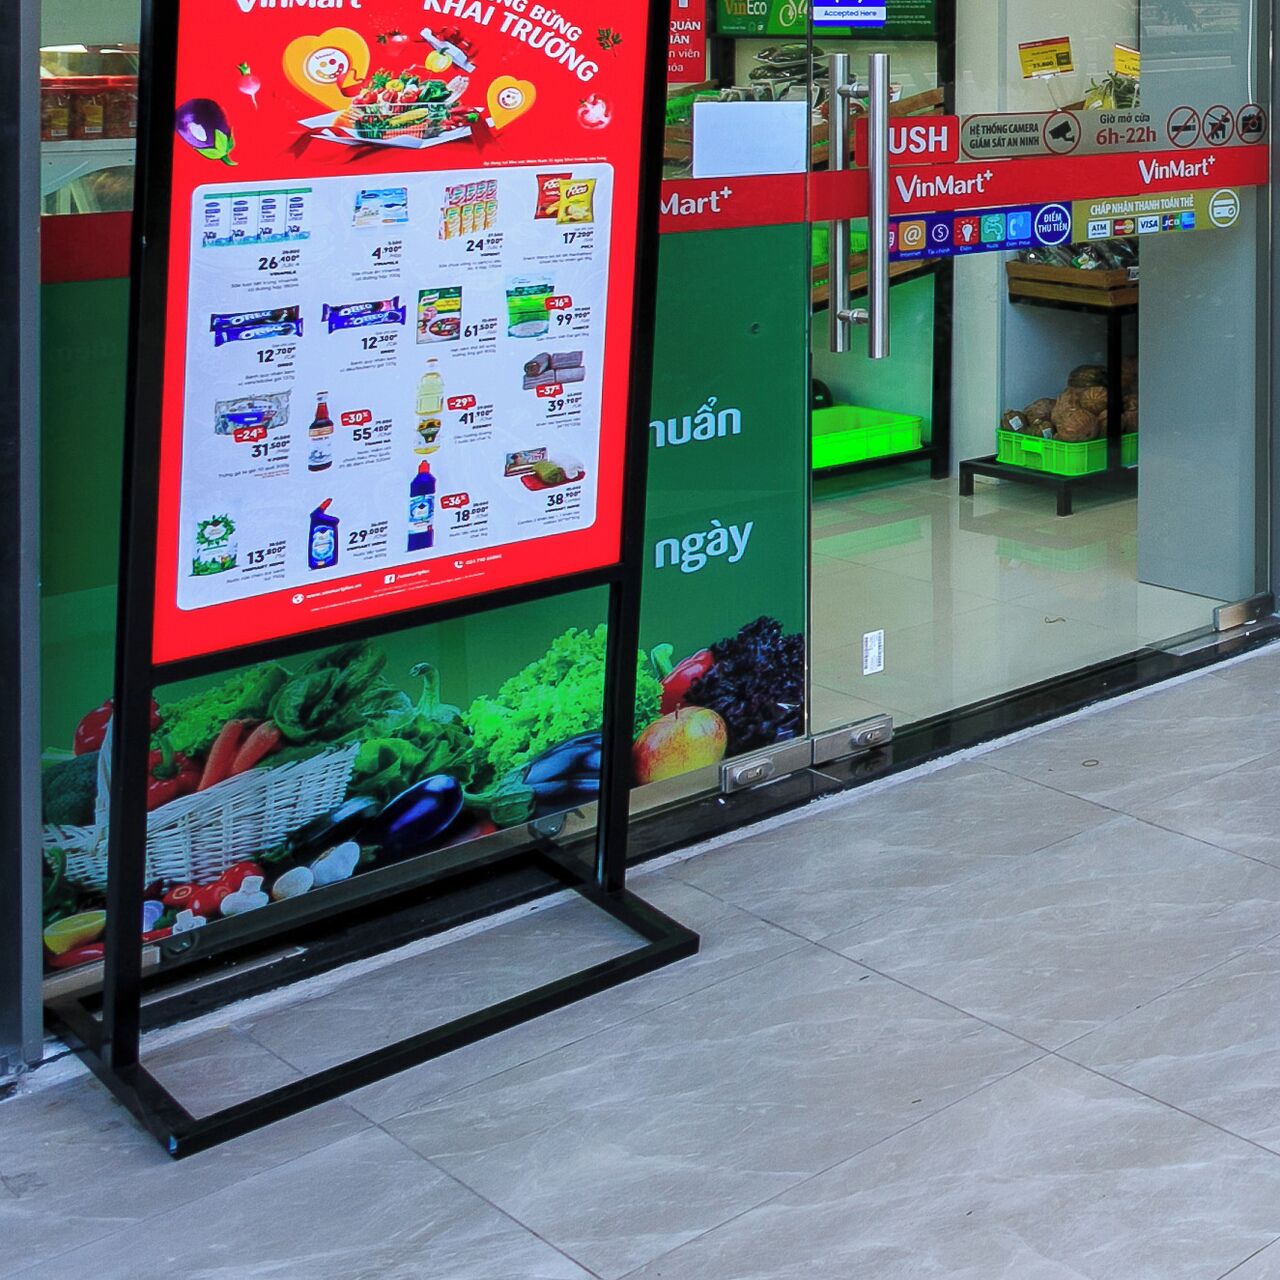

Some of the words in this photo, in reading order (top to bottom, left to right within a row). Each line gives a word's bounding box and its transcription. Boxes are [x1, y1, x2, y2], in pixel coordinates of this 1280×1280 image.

[529, 4, 583, 42] BỪNG
[824, 9, 859, 18] Accepted
[499, 10, 599, 83] TRƯƠNG
[1100, 114, 1115, 124] Giờ
[970, 125, 980, 136] HỆ
[982, 122, 1007, 135] THỐNG
[1009, 123, 1038, 134] CAMERA
[1096, 126, 1156, 145] 6h-22h
[889, 125, 947, 154] USH
[970, 137, 990, 149] GIÁM
[992, 136, 1006, 148] SÁT
[1007, 138, 1018, 147] AN
[1020, 136, 1039, 146] NINH
[661, 186, 732, 216] Mart+
[1090, 200, 1111, 215] CHẤP
[1135, 199, 1160, 211] THANH
[1161, 196, 1180, 209] TOÁN
[1092, 223, 1107, 232] ATM
[1141, 220, 1158, 229] VISA
[655, 520, 753, 573] ngày
